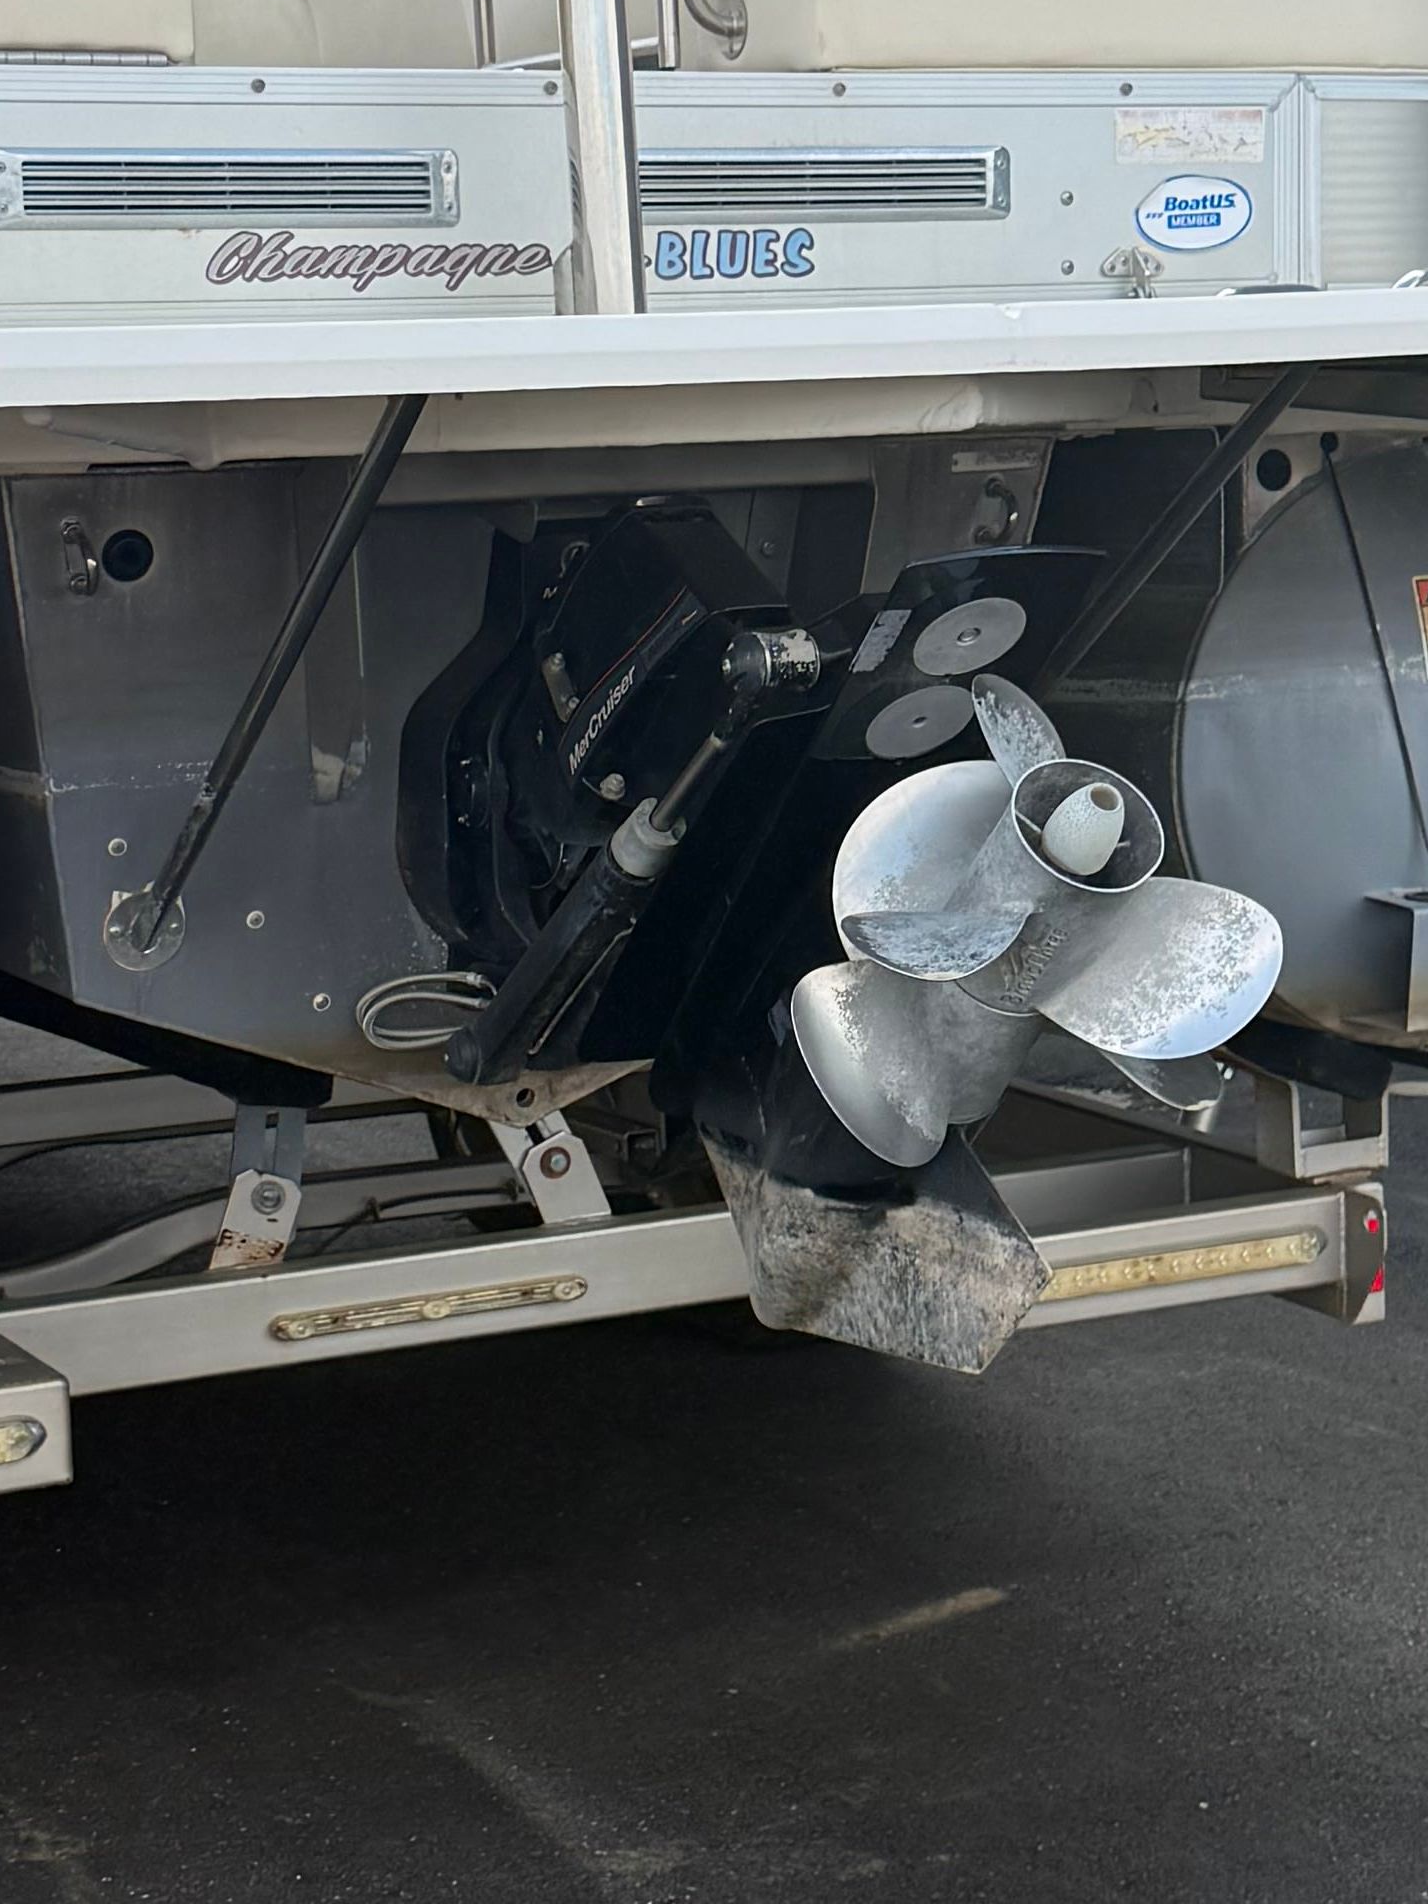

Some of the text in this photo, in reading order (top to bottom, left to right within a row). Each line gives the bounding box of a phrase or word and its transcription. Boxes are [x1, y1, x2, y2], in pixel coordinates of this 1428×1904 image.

[1164, 193, 1237, 211] BoatUS
[206, 227, 815, 292] Champagne BLUES
[568, 664, 637, 776] MerCruiser
